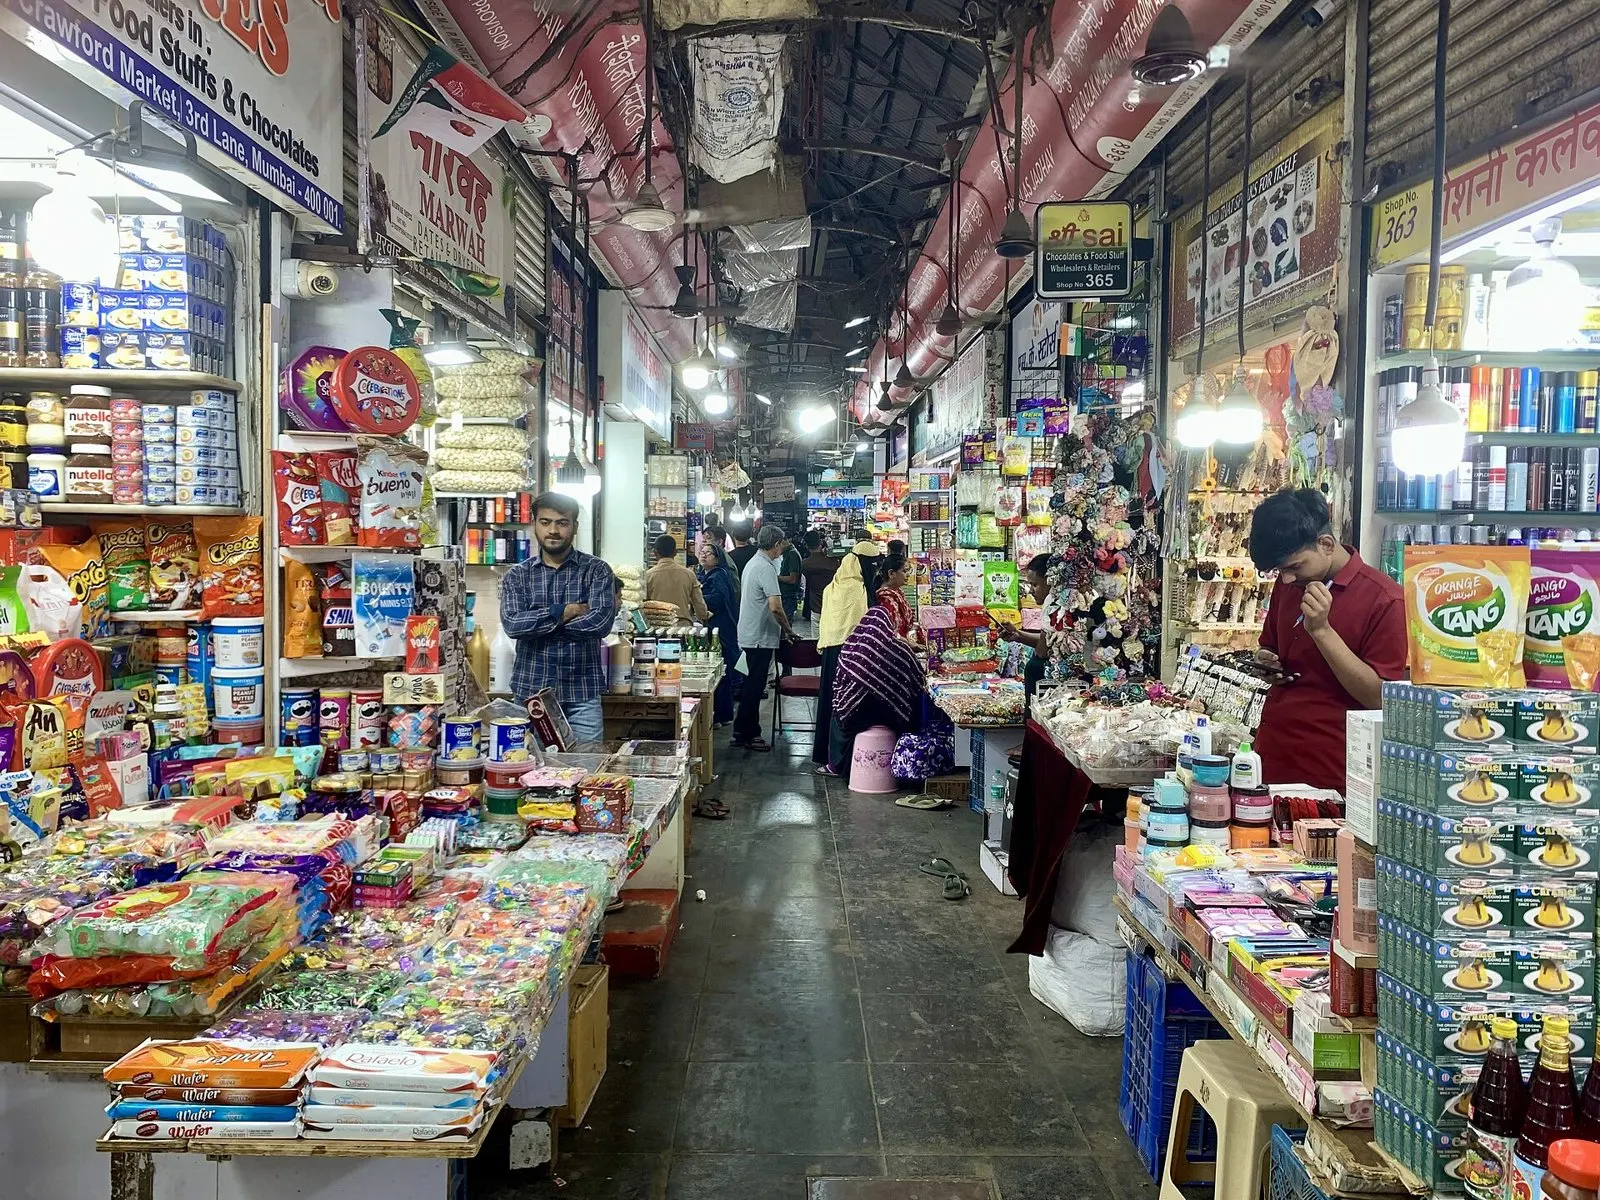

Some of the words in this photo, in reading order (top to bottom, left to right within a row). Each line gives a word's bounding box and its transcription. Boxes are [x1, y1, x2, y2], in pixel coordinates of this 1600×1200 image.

[159, 26, 218, 101] Stuffs
[222, 77, 236, 116] &
[239, 92, 320, 178] Chocolates
[185, 101, 209, 137] 3rd
[251, 145, 296, 198] Mumbai
[304, 185, 323, 216] 400
[1258, 171, 1272, 193] FOR
[1273, 152, 1298, 184] ITSELF
[1384, 198, 1404, 215] Shop
[1405, 190, 1419, 207] No.
[420, 180, 486, 268] MARWAH
[1082, 221, 1123, 248] sai
[1382, 204, 1418, 250] 363
[1046, 252, 1082, 261] Chocolates
[1084, 251, 1089, 260] &
[1091, 251, 1107, 260] Food
[1109, 251, 1125, 260] Stuff
[1050, 264, 1087, 272] Wholesalers
[1094, 263, 1120, 271] Retailers
[1085, 274, 1114, 287] 365
[367, 477, 411, 497] bueno
[1586, 472, 1597, 504] BOSS
[207, 536, 261, 566] Cheetos
[361, 582, 412, 596] BOUNTY
[1434, 576, 1482, 595] ORANGE
[1438, 598, 1499, 632] TANG
[1527, 602, 1589, 636] TANG
[170, 1072, 209, 1086] Wafer
[182, 1088, 221, 1102] Wafer
[176, 1109, 216, 1122] Wafer
[168, 1125, 213, 1139] Wafer
